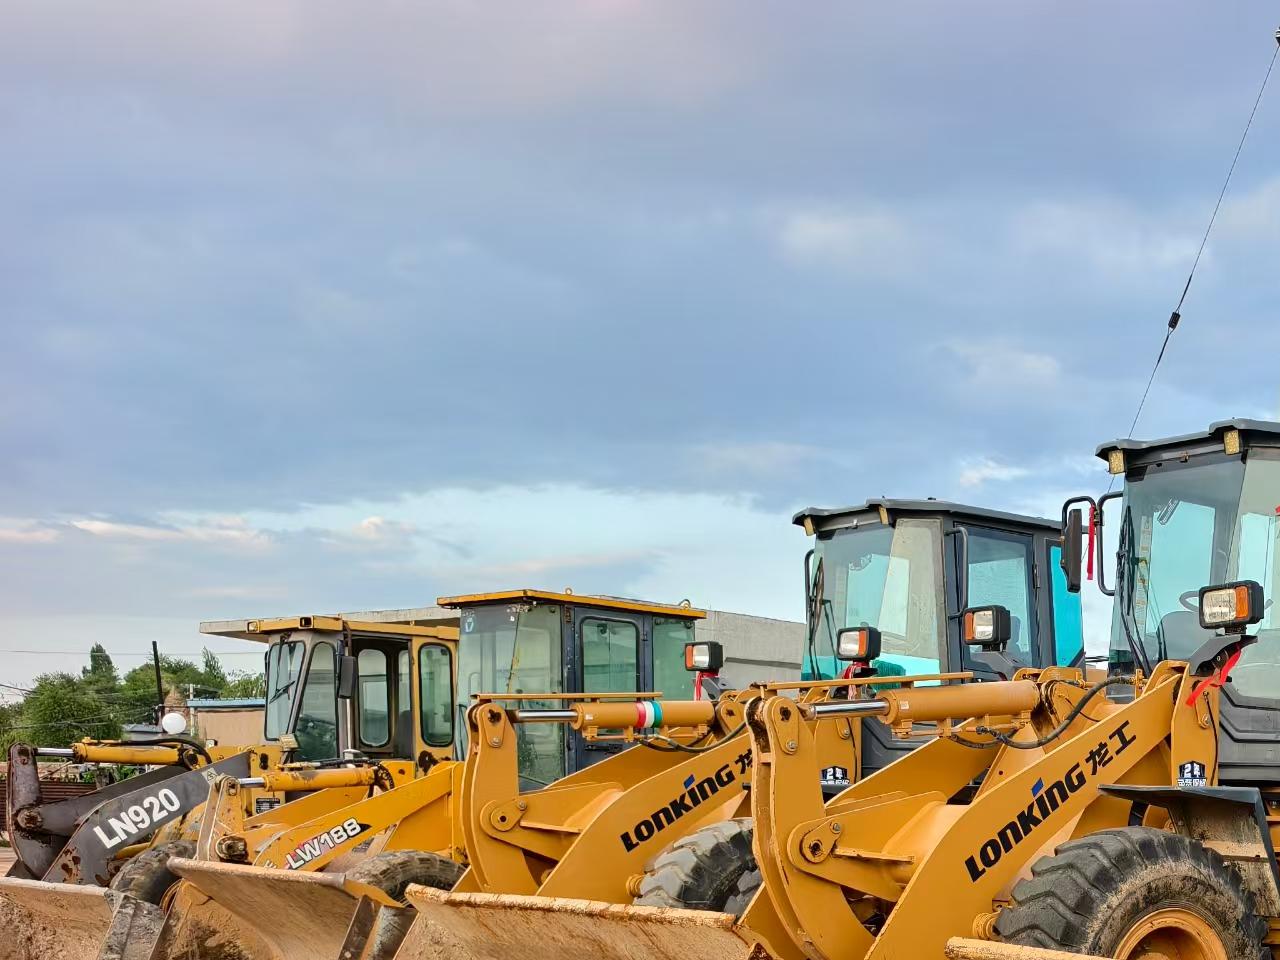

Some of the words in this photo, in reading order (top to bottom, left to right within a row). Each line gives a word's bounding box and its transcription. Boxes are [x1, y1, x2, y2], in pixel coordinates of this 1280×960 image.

[93, 787, 181, 849] LN920
[619, 763, 736, 852] LONKING
[964, 763, 1087, 883] LONKING
[1085, 720, 1137, 775] 龙工
[285, 817, 362, 870] LW188
